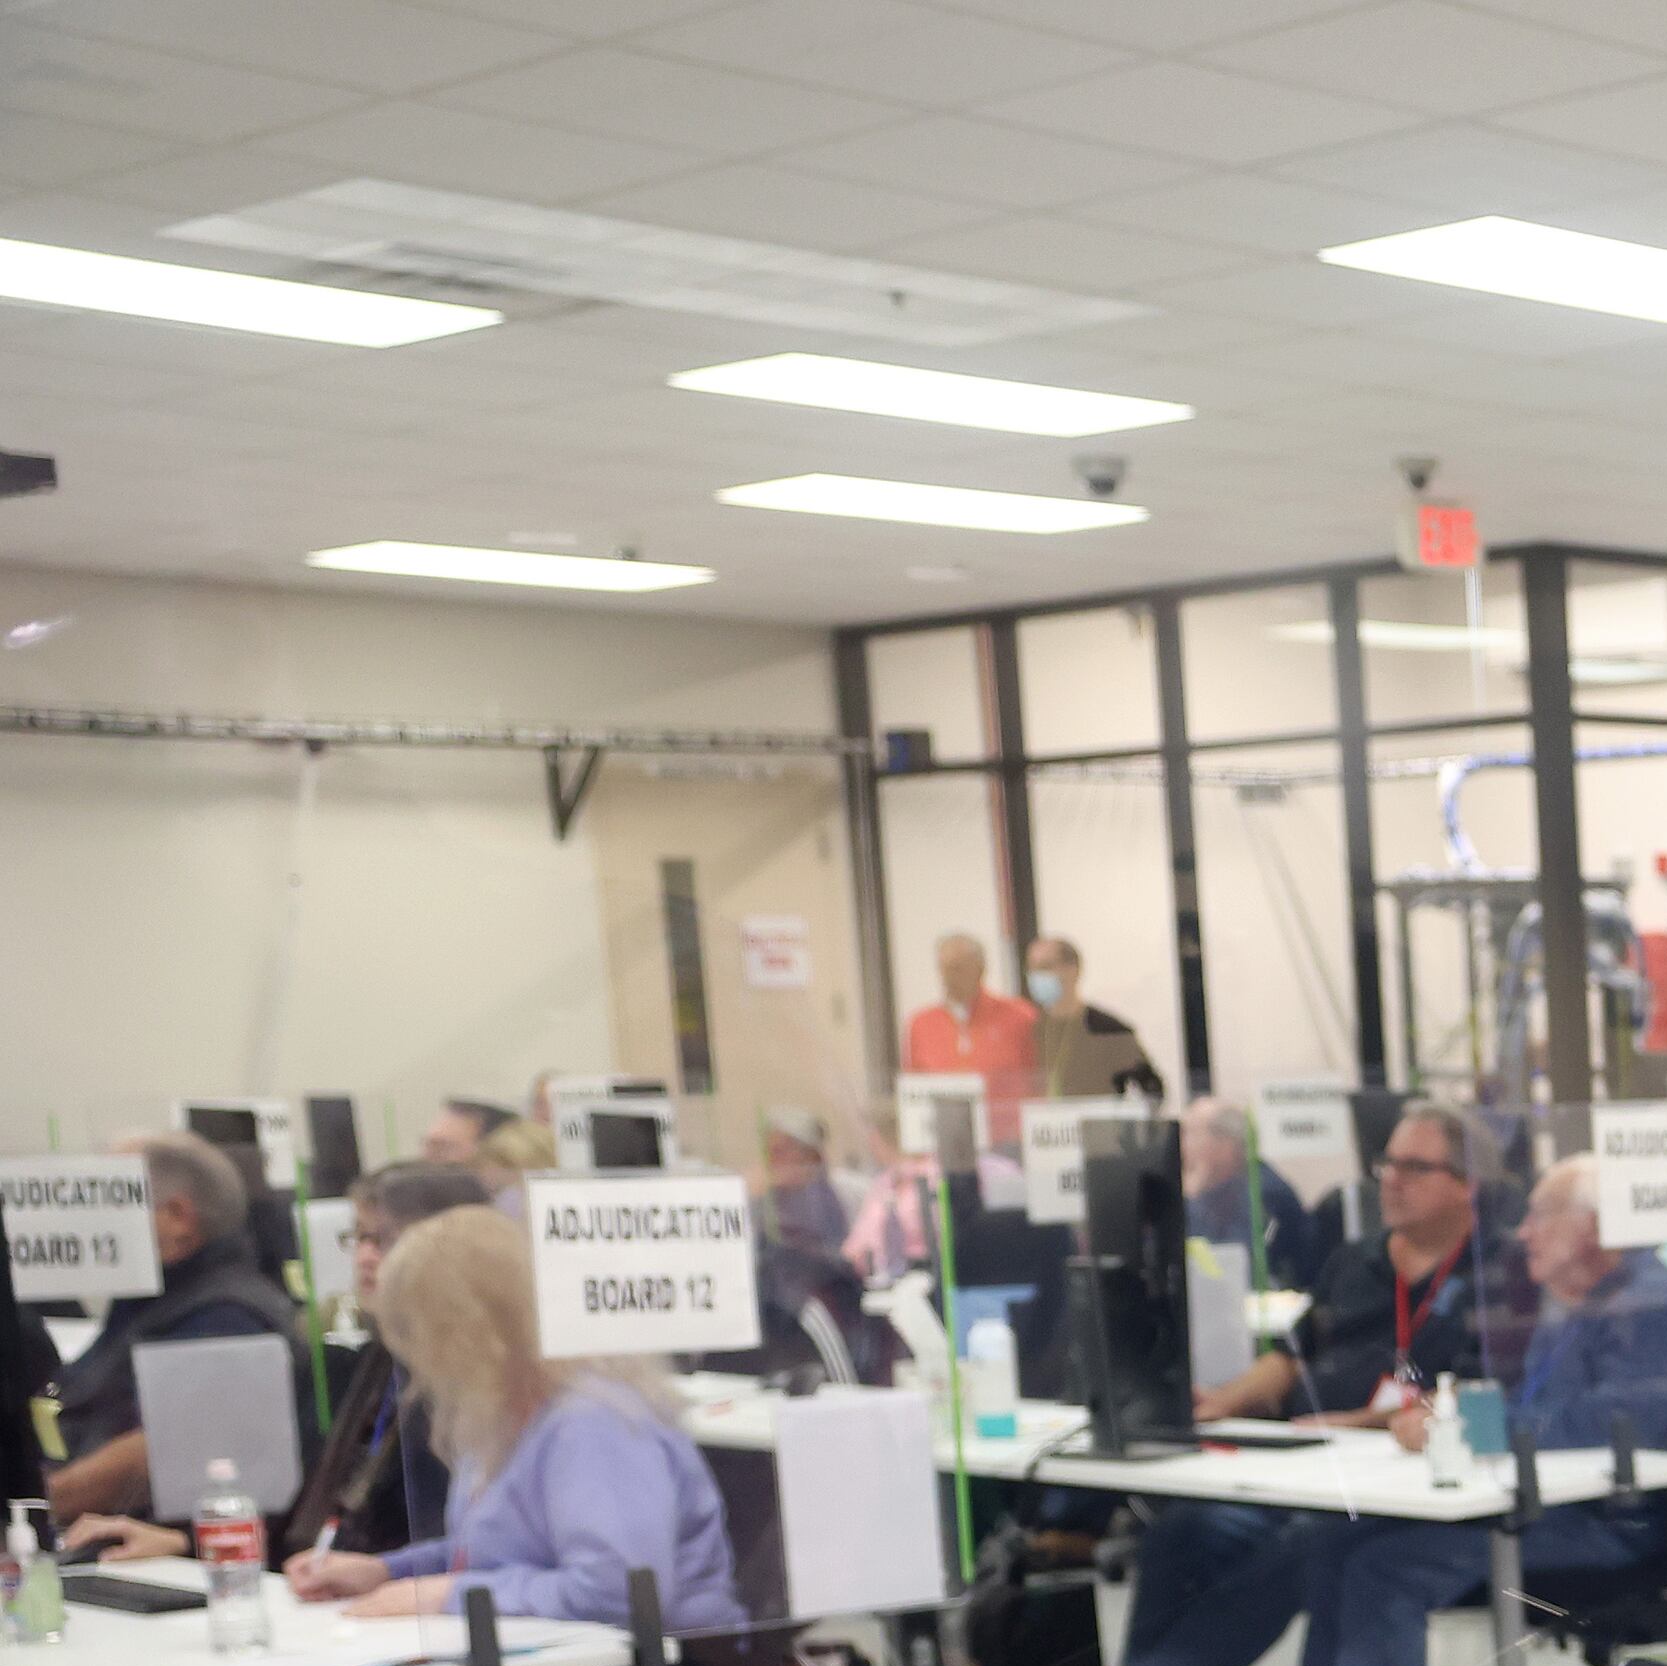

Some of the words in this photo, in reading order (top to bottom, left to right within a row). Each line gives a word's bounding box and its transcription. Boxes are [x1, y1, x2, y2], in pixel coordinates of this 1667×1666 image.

[544, 1204, 744, 1242] ADJUDICATION
[10, 1235, 82, 1267] OARD
[585, 1275, 675, 1314] BOARD
[686, 1275, 715, 1311] 12
